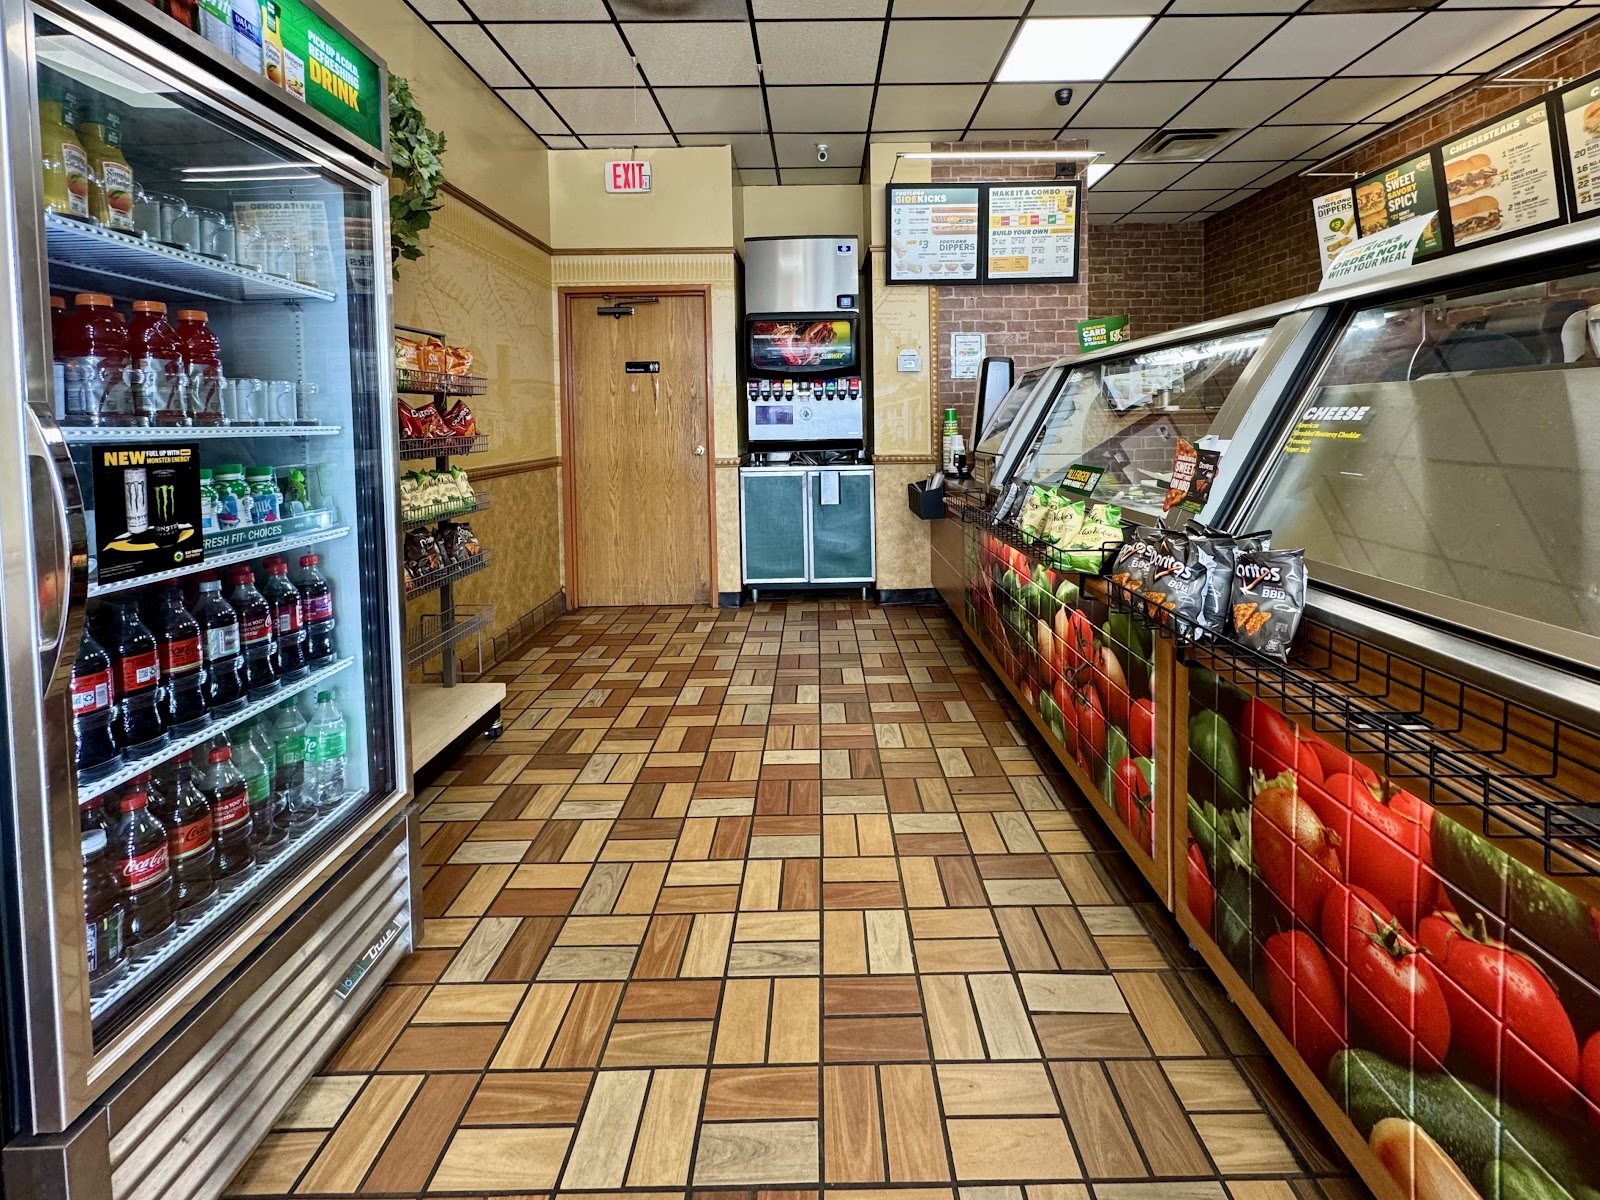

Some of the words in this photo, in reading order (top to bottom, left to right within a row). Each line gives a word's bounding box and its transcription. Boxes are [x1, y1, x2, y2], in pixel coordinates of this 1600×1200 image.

[308, 29, 325, 51] PICK
[325, 43, 335, 58] UP
[335, 51, 341, 63] A
[341, 56, 359, 78] COLD,
[308, 41, 359, 90] REFRESHING
[309, 56, 360, 113] DRINK
[1449, 119, 1520, 155] CHEESESTEAKS
[1574, 148, 1586, 159] 20
[613, 163, 644, 189] EXIT
[1576, 163, 1589, 174] 16
[1386, 171, 1415, 193] SWEET
[1578, 179, 1589, 190] 22
[895, 194, 947, 204] SIDEKICKS
[1324, 193, 1342, 202] NEW
[1387, 183, 1417, 200] SAVORY
[1317, 196, 1352, 211] FOOTLONG
[1388, 191, 1418, 213] SPICY
[1581, 195, 1592, 204] 21
[1318, 202, 1352, 218] DIPPERS
[1507, 204, 1513, 212] 2
[919, 240, 929, 249] $3
[939, 243, 975, 251] DIPPERS
[1332, 251, 1375, 270] ORDER
[1376, 239, 1413, 258] NOW
[1328, 266, 1352, 280] WITH
[1353, 259, 1378, 273] YOUR
[1380, 251, 1407, 265] MEAL
[1082, 328, 1107, 337] CARD
[1302, 406, 1371, 421] CHEESE
[1288, 437, 1312, 445] Provolone
[1338, 431, 1362, 439] Cheddar
[1284, 445, 1300, 454] Pepper
[1299, 446, 1311, 454] Jack
[104, 451, 146, 467] NEW
[1199, 461, 1214, 470] Doritos
[1175, 461, 1197, 476] SWEET
[248, 525, 283, 540] CHOICES
[1149, 550, 1192, 580] Doritos
[1236, 563, 1282, 582] oritos
[1167, 579, 1189, 593] BBQ
[1261, 588, 1286, 600] BBQ
[362, 929, 396, 960] True
